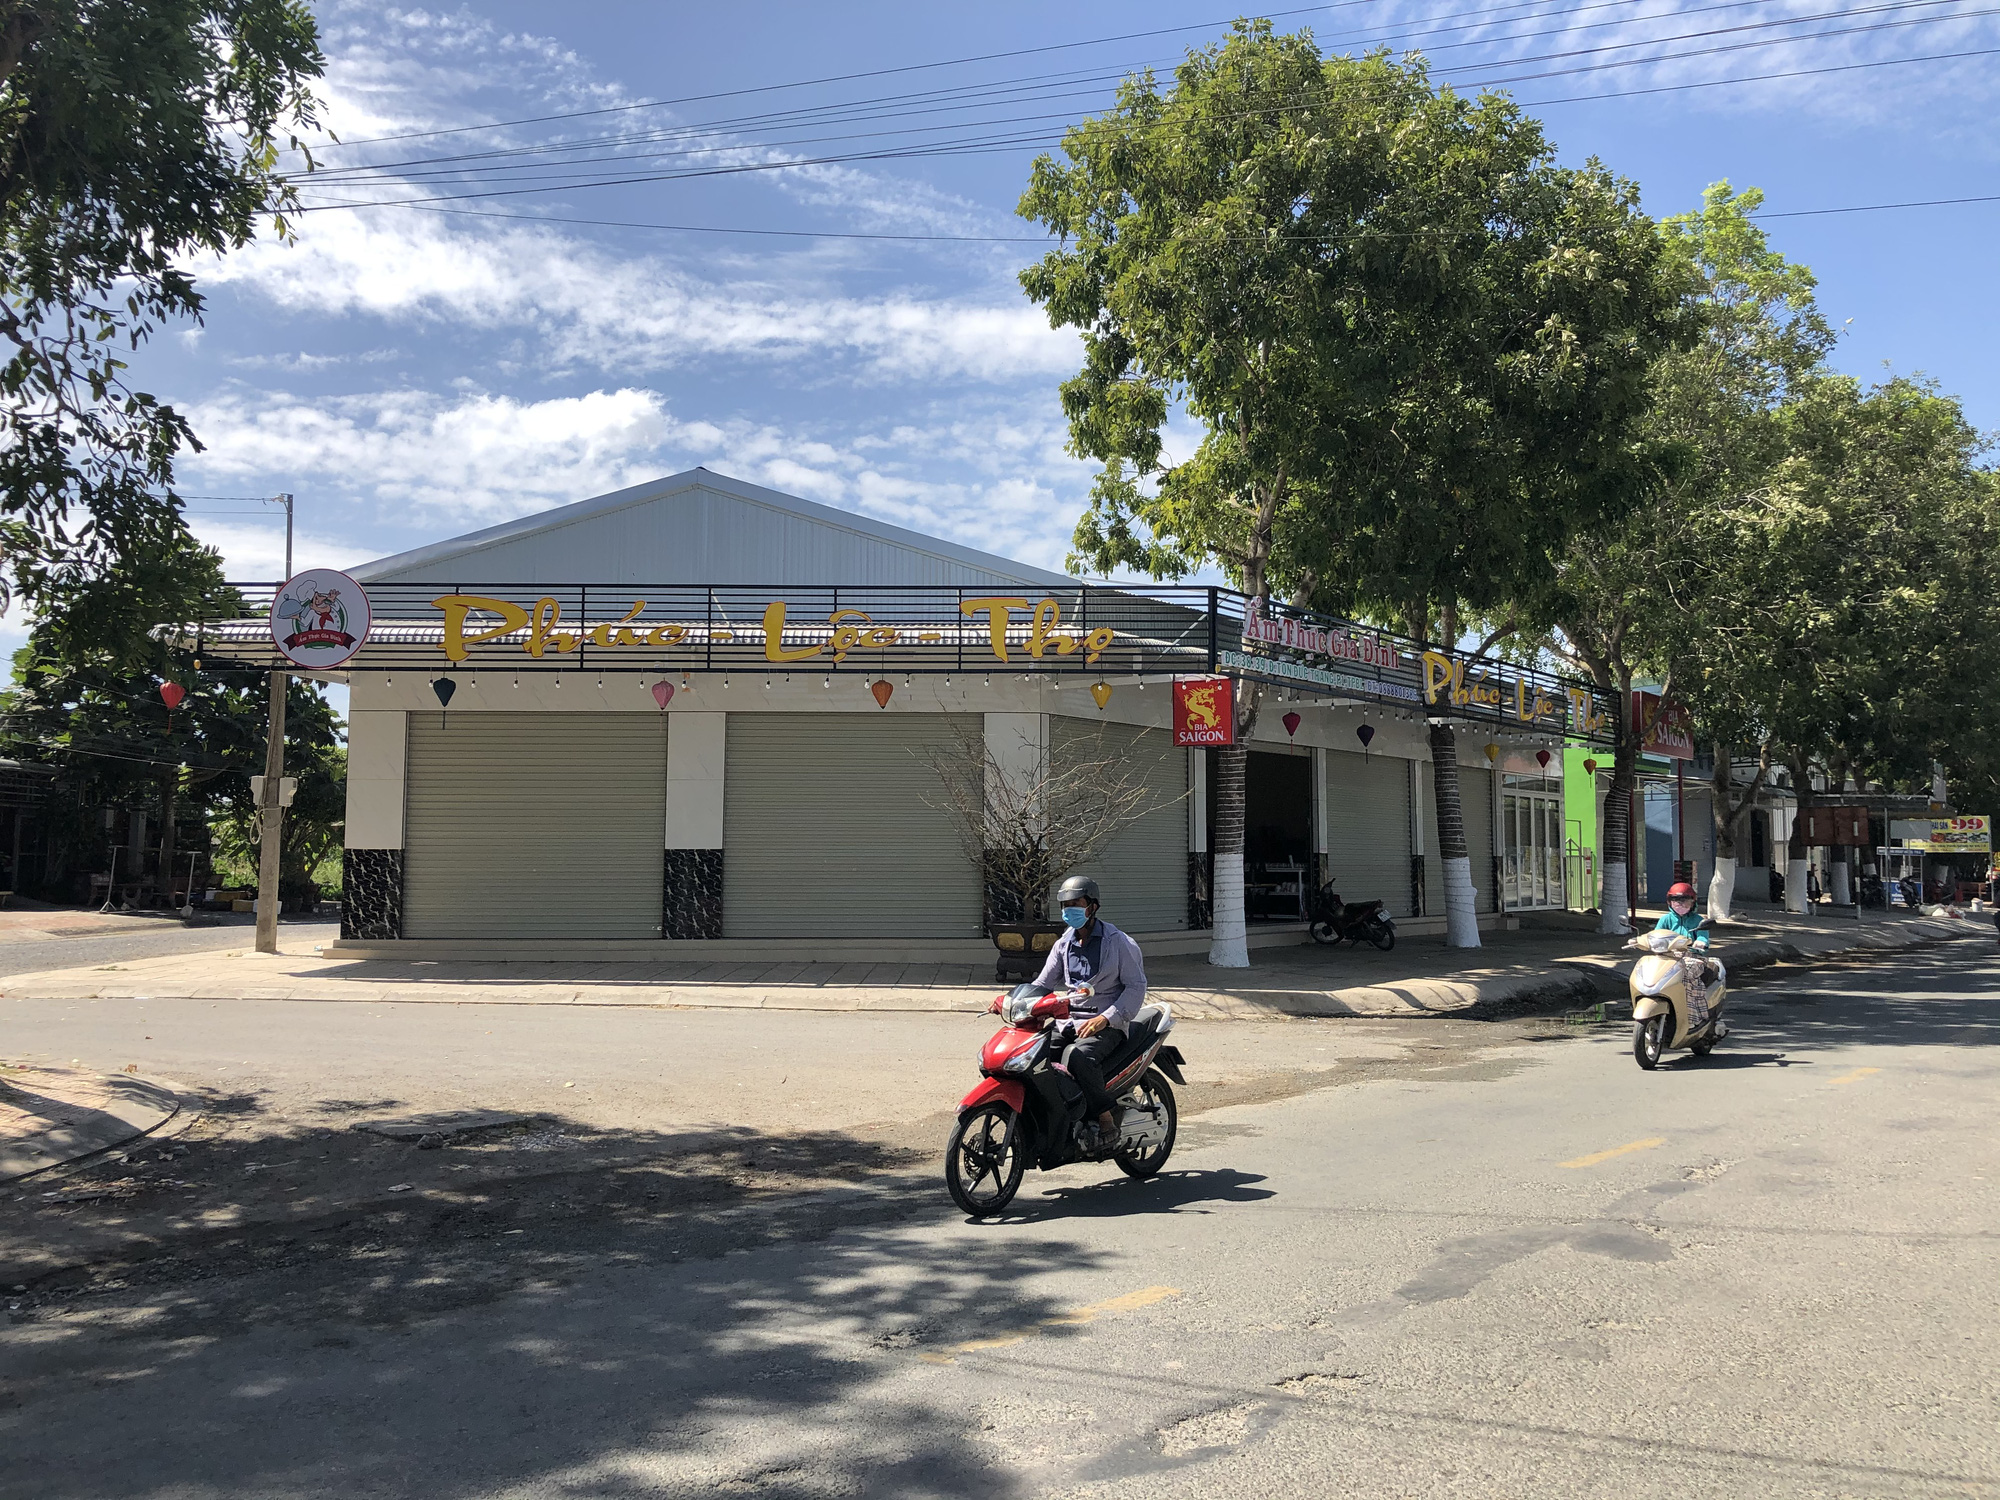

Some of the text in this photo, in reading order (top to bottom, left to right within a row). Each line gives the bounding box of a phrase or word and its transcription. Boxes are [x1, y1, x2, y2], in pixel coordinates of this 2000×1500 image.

[431, 594, 689, 662] Phúc
[762, 601, 902, 663] Lộc
[959, 597, 1114, 664] Thọ
[1331, 628, 1358, 660] Gia
[1362, 634, 1399, 669] Đình
[1421, 650, 1500, 705] Phúc
[1517, 677, 1553, 723] Lộc
[1568, 687, 1605, 735] Thọ
[1179, 730, 1224, 743] SAIGON
[1194, 723, 1209, 731] BIA
[1951, 818, 1984, 831] 99
